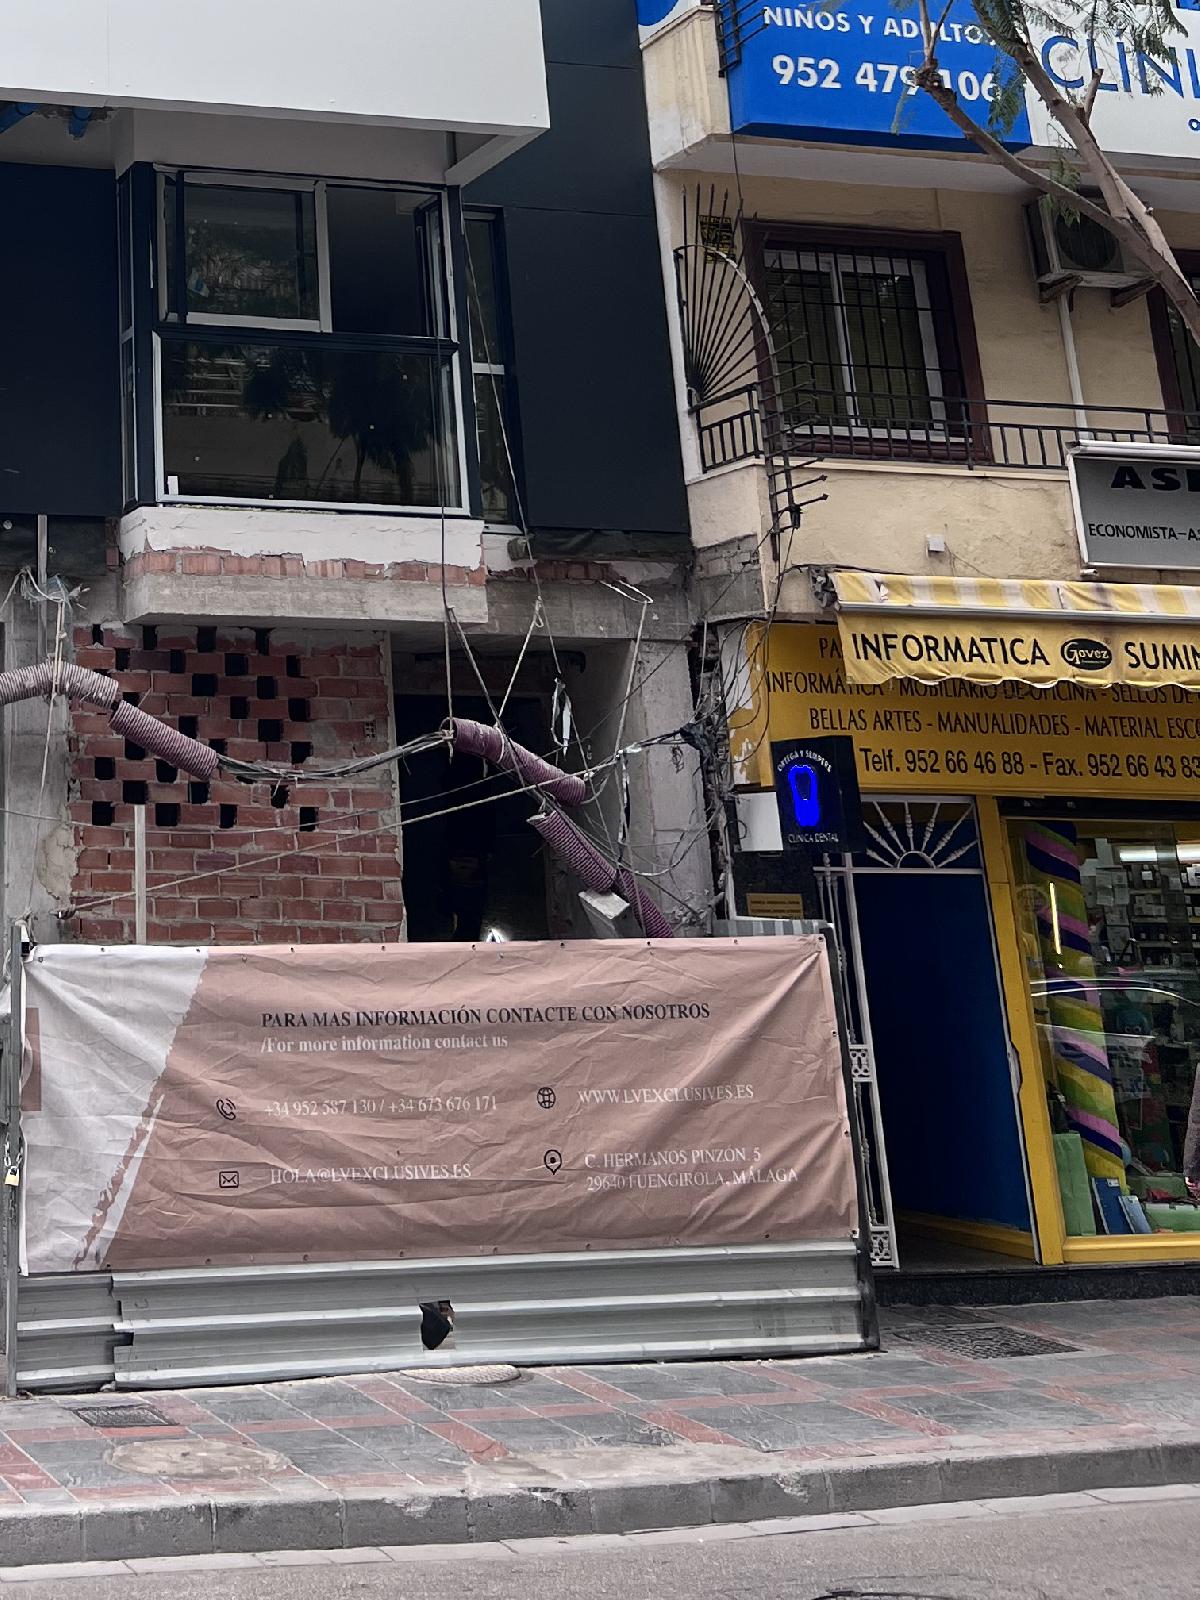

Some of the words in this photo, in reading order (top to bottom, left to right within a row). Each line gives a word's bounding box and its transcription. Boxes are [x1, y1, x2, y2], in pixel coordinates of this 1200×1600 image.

[763, 3, 851, 33] NIÑOS
[858, 14, 875, 35] Y
[772, 54, 842, 90] 952
[854, 61, 923, 97] 479
[852, 632, 1051, 666] INFORMATICA
[809, 707, 868, 731] BELLAS
[873, 709, 922, 732] ARTES
[937, 711, 1070, 736] MANUALIDADES
[1085, 715, 1164, 738] MATERIAL
[859, 747, 900, 772] Telf.
[904, 749, 940, 774] 952
[945, 750, 969, 774] 66
[973, 750, 997, 775] 46
[1001, 751, 1025, 776] 88
[1042, 752, 1084, 777] Fax.
[1087, 752, 1123, 777] 952
[1125, 754, 1149, 778] 66
[1154, 754, 1177, 779] 43
[260, 1012, 309, 1028] PARA
[312, 1011, 351, 1027] MAS
[355, 1005, 482, 1027] INFORMACIÓN
[486, 1006, 578, 1024] CONTACTE
[581, 1005, 618, 1022] CON
[621, 1002, 711, 1021] NOSOTROS
[299, 1037, 338, 1053] more
[341, 1033, 431, 1052] information
[434, 1035, 489, 1051] contact
[491, 1035, 508, 1049] us
[264, 1102, 290, 1117] +34
[292, 1101, 318, 1116] 952
[321, 1100, 347, 1115] 587
[351, 1099, 375, 1115] 130
[388, 1098, 415, 1113] +34
[418, 1096, 443, 1112] 673
[446, 1096, 471, 1111] 676
[475, 1095, 497, 1111] 171
[603, 1150, 688, 1169] HERMANOS
[752, 1147, 761, 1162] 5
[587, 1174, 626, 1191] 29640
[732, 1165, 799, 1185] MÁLAGA
